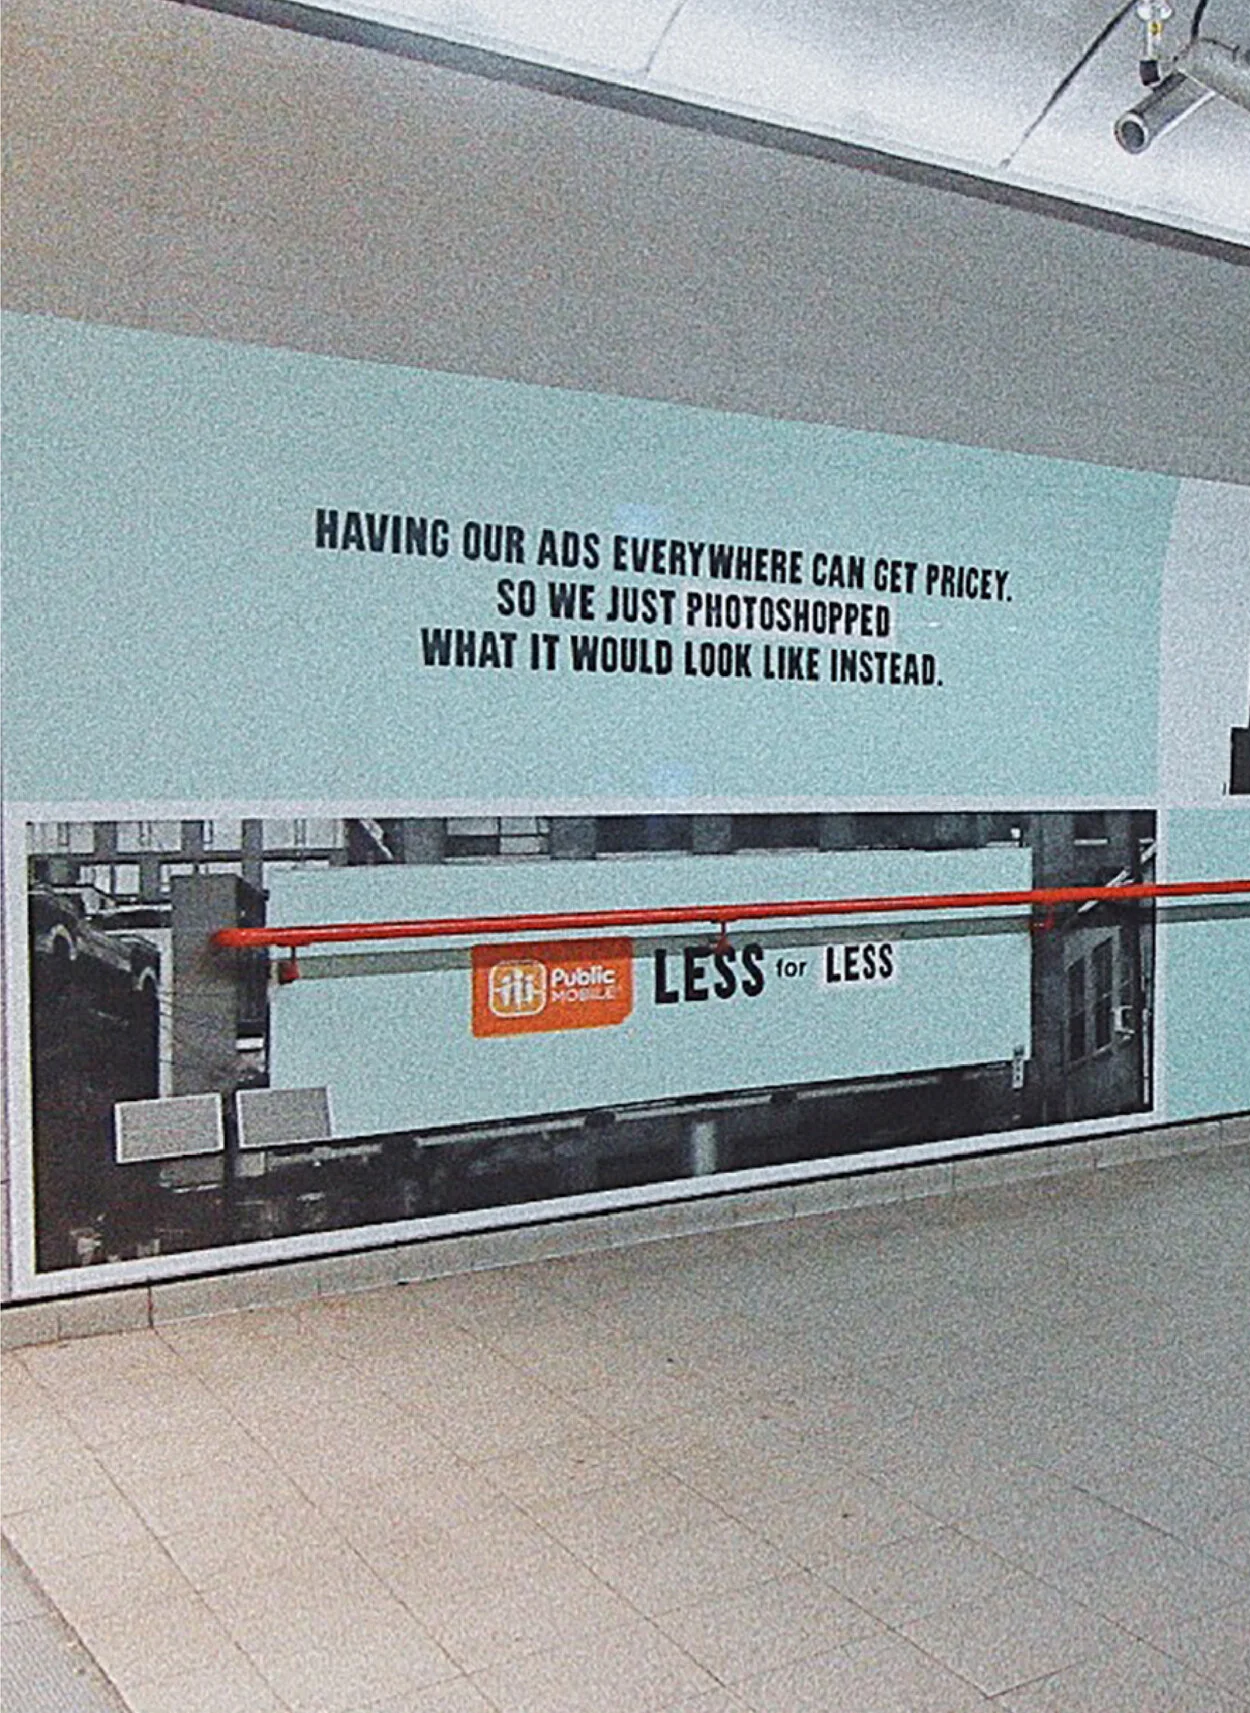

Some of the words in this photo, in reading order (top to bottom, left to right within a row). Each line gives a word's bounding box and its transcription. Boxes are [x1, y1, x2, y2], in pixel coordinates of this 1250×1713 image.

[315, 508, 449, 558] HAVING
[463, 521, 525, 564] OUR
[537, 529, 600, 569] ADS
[613, 535, 803, 585] EVERYWHERE
[812, 552, 865, 590] CAN
[874, 558, 918, 594] GET
[926, 563, 1012, 602] PRICEY.
[497, 578, 536, 617] SO
[548, 582, 595, 620] WE
[606, 585, 676, 625] JUST
[686, 592, 890, 637] PHOTOSHOPPED
[421, 628, 517, 668] WHAT
[530, 633, 560, 670] IT
[571, 635, 672, 675] WOULD
[684, 641, 752, 678] LOOK
[763, 644, 821, 681] LIKE
[830, 648, 943, 686] INSTEAD.
[552, 965, 615, 987] Public
[552, 986, 615, 1002] MOBILE
[654, 943, 766, 1004] LESS
[776, 959, 807, 978] for
[825, 943, 893, 983] LESS
